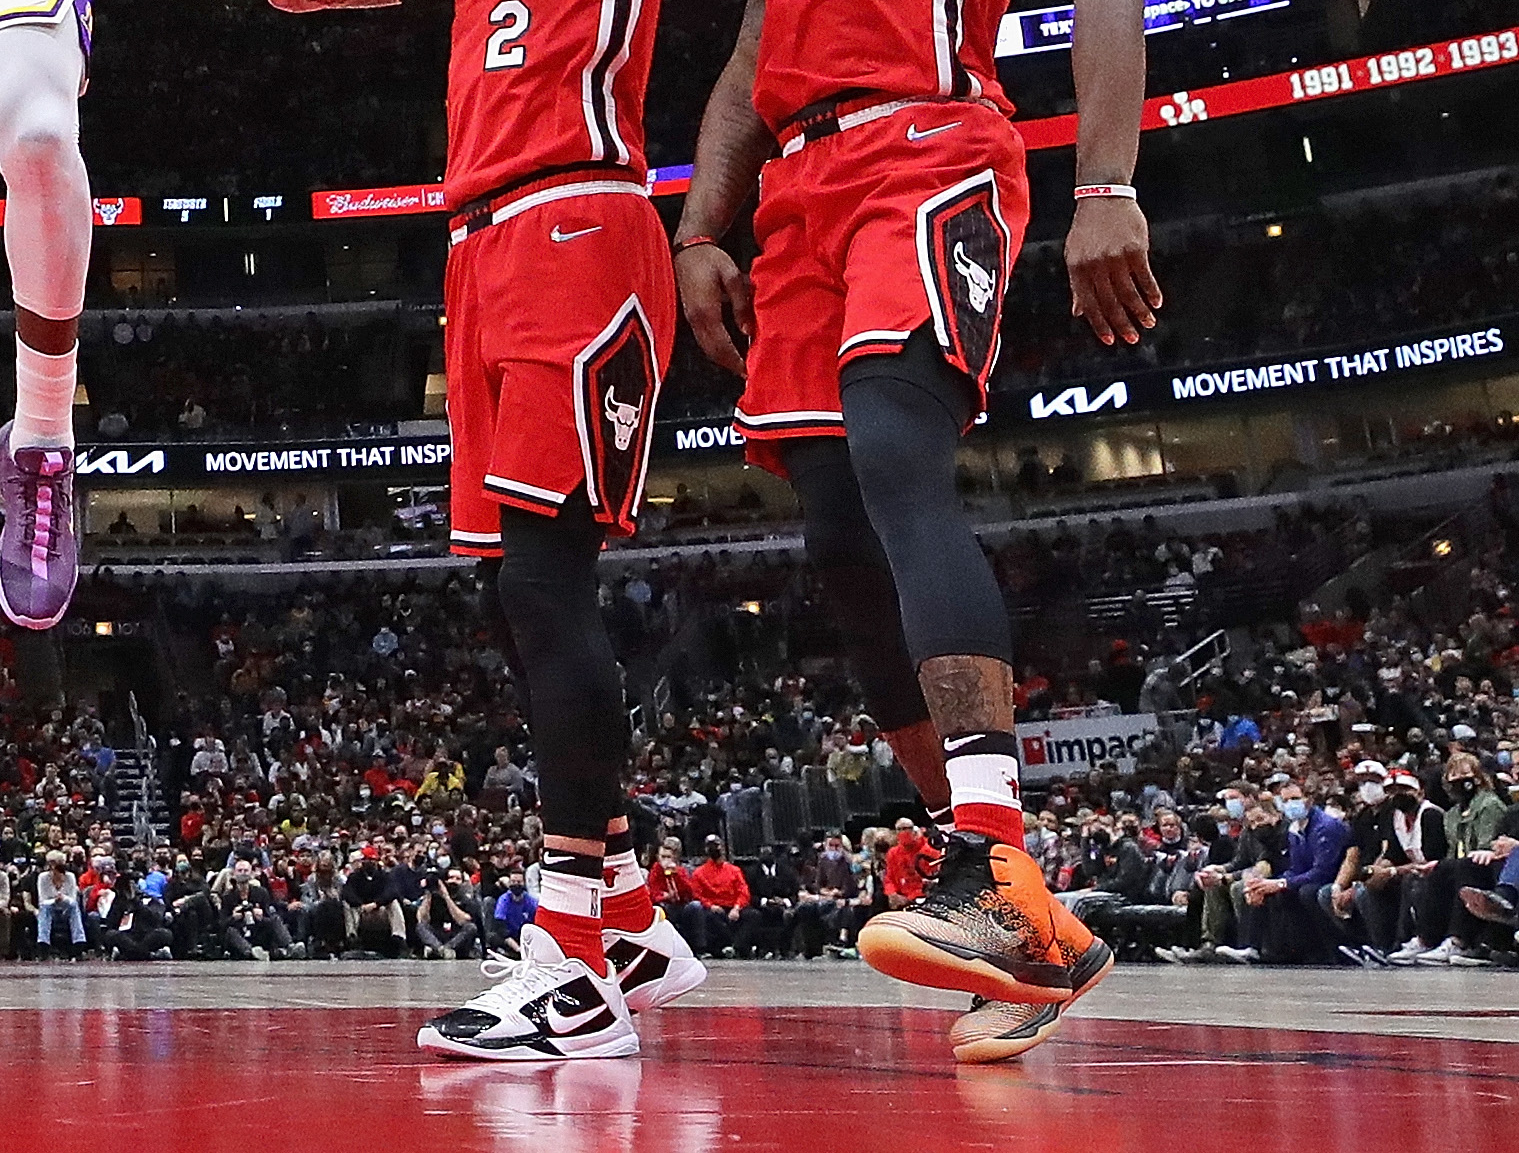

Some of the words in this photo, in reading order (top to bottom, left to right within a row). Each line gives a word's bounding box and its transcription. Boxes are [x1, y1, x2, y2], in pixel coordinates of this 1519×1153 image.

[1289, 66, 1354, 100] 1991
[1366, 46, 1438, 85] 1992
[1448, 30, 1518, 69] 1993
[325, 192, 419, 214] Budweiser
[1172, 359, 1319, 400] MOVEMENT
[1323, 348, 1390, 381] THAT
[1394, 327, 1504, 369] INSPIRES
[1030, 381, 1128, 419] KIA
[676, 426, 746, 452] MOVE
[205, 448, 332, 473] MOVEMENT
[336, 446, 395, 468] THAT
[400, 444, 449, 466] INSP
